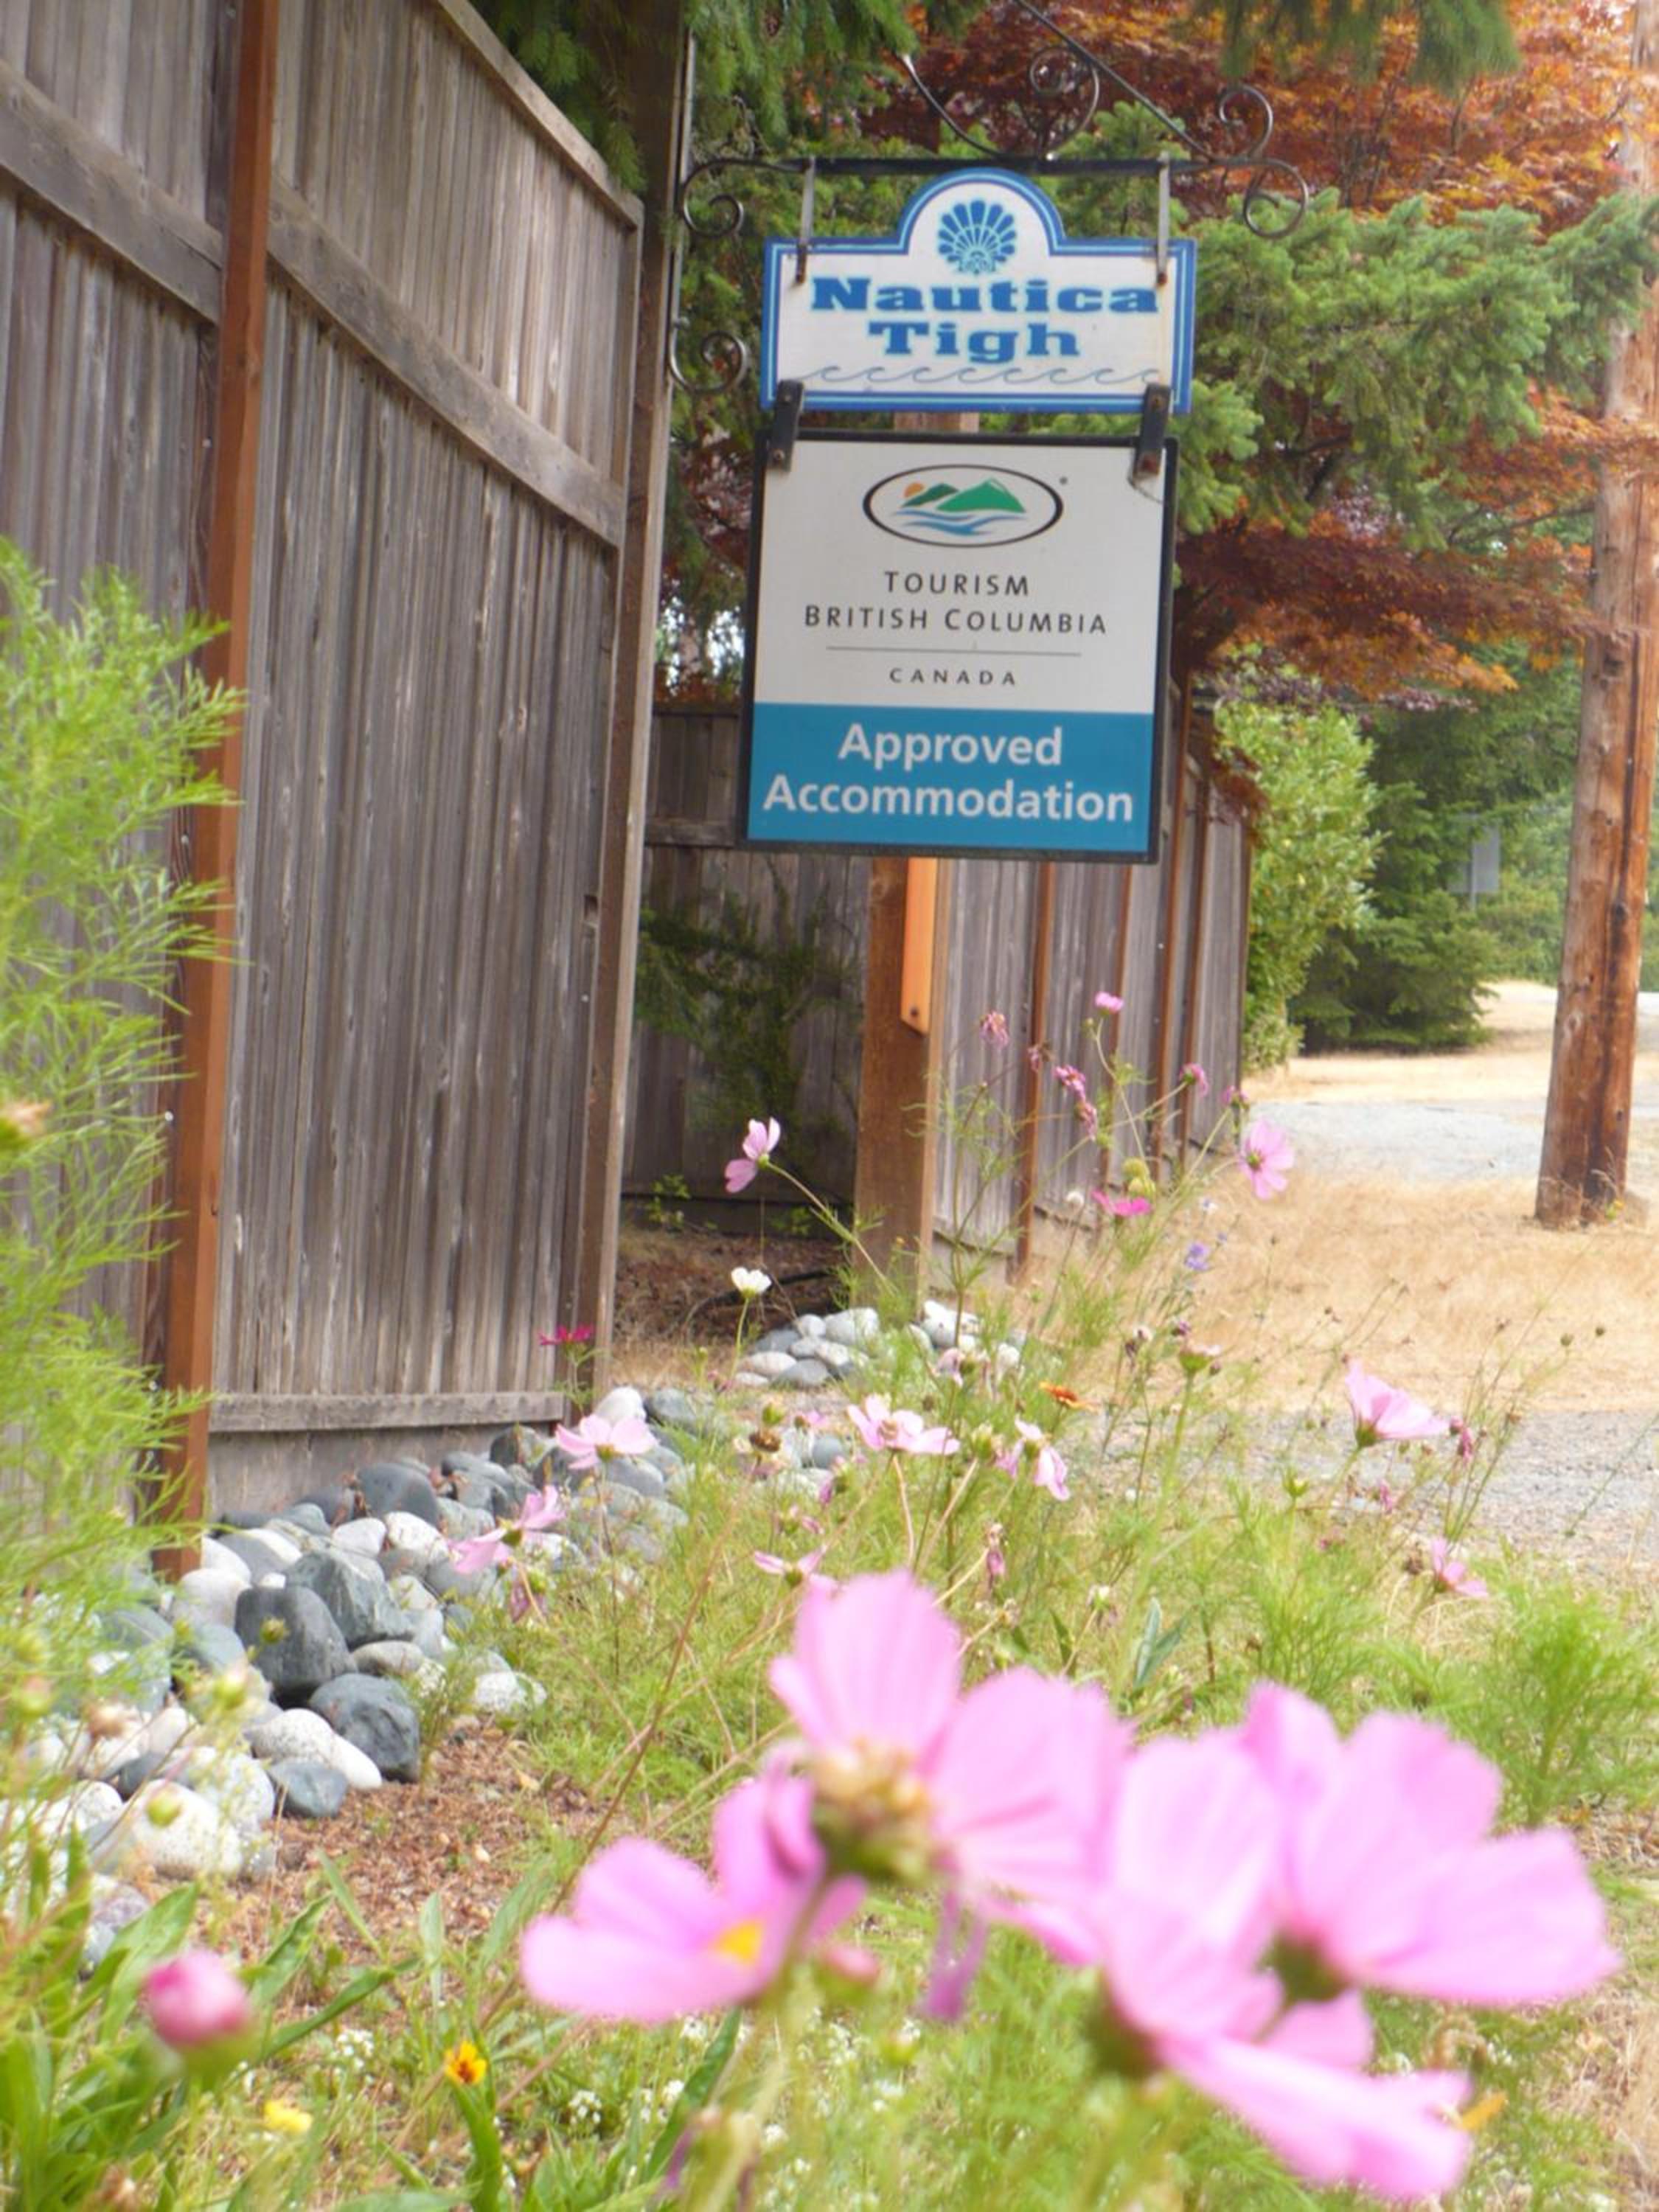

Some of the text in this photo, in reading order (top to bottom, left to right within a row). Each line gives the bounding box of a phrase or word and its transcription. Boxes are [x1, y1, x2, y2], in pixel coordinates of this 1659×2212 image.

[812, 276, 1159, 313] Nautica
[868, 321, 1080, 364] Tigh
[885, 571, 1029, 597] TOURISM
[804, 605, 1106, 635] BRITISH COLUMBIA
[889, 667, 1016, 686] CANADA
[838, 723, 1062, 771] Approved
[762, 774, 1133, 822] Accommodation
